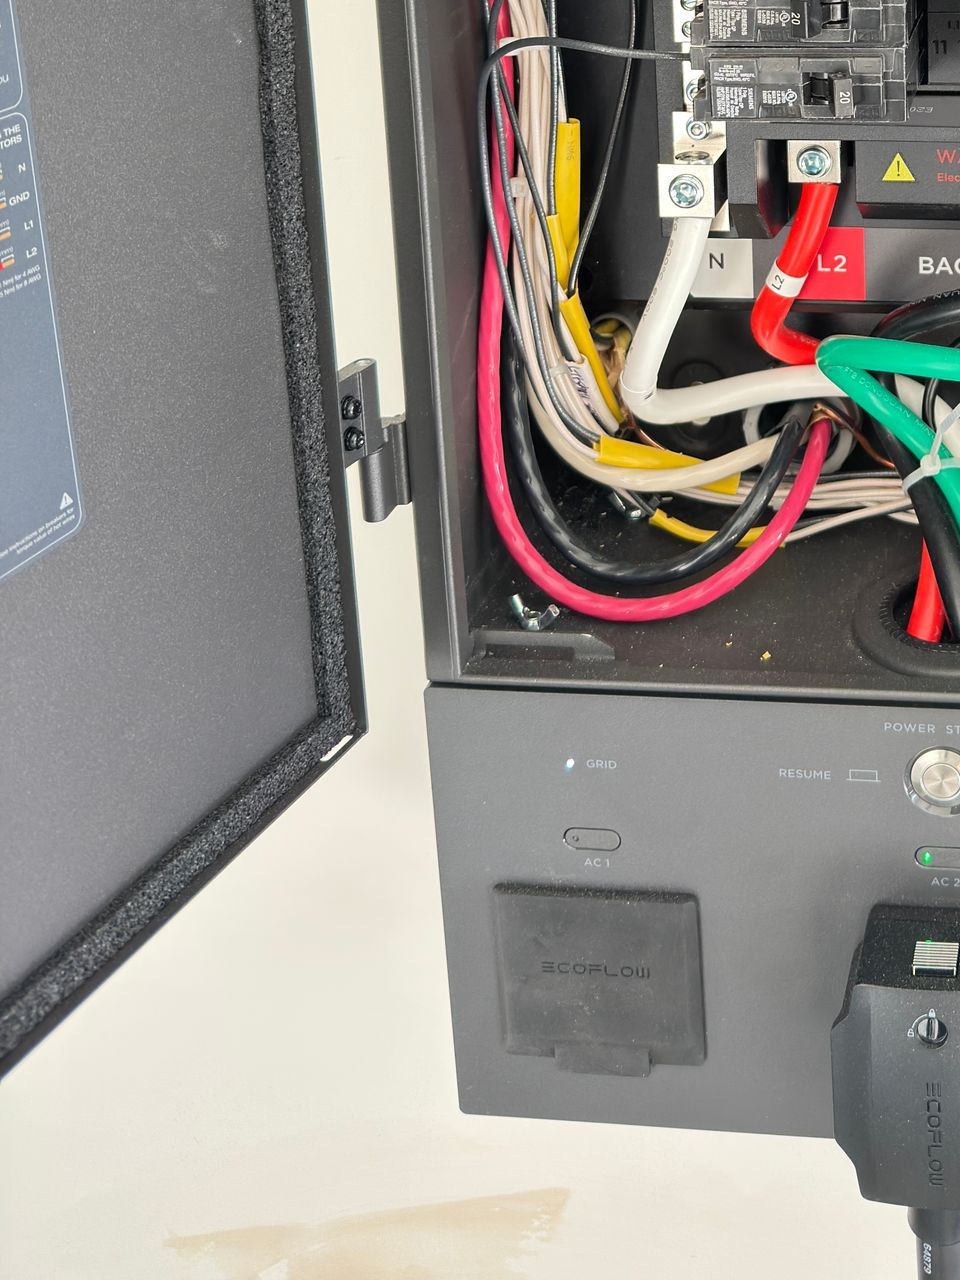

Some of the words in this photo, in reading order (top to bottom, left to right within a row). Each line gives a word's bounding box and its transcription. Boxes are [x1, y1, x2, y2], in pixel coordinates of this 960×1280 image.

[791, 13, 800, 25] 20
[932, 40, 947, 54] 11
[839, 91, 851, 104] 20
[18, 162, 26, 174] N
[9, 191, 30, 206] GND
[24, 220, 34, 231] L1
[26, 247, 38, 259] L2
[709, 252, 724, 269] N
[817, 255, 847, 273] L2
[771, 274, 785, 291] L2
[884, 722, 936, 733] POWER
[586, 759, 617, 769] GRID
[779, 768, 832, 780] RESUME
[584, 858, 601, 867] AC
[931, 877, 950, 887] AC
[953, 878, 960, 887] 2
[541, 961, 650, 980] ECOFLOW
